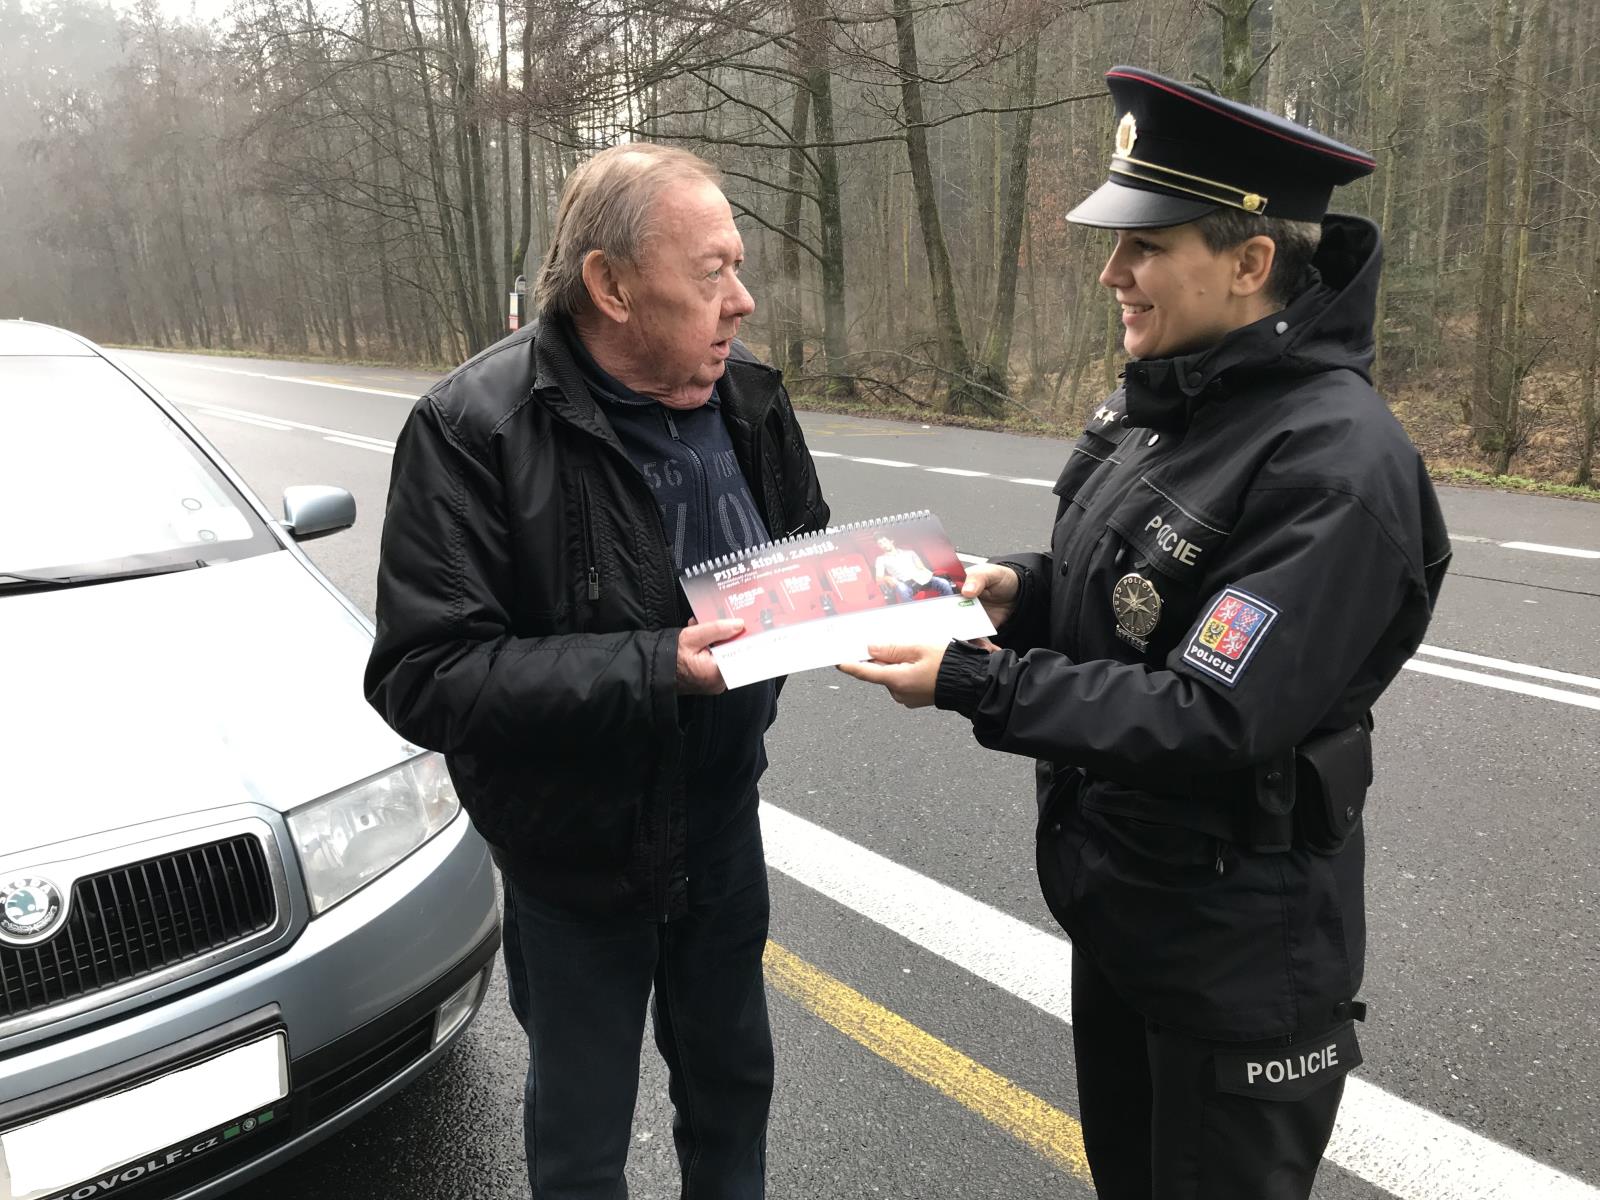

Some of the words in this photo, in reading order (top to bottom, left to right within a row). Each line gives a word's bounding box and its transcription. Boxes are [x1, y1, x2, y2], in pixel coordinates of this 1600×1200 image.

[1144, 515, 1203, 566] POLCIE
[1190, 645, 1236, 675] POLICIE
[1246, 1043, 1339, 1084] POLICIE
